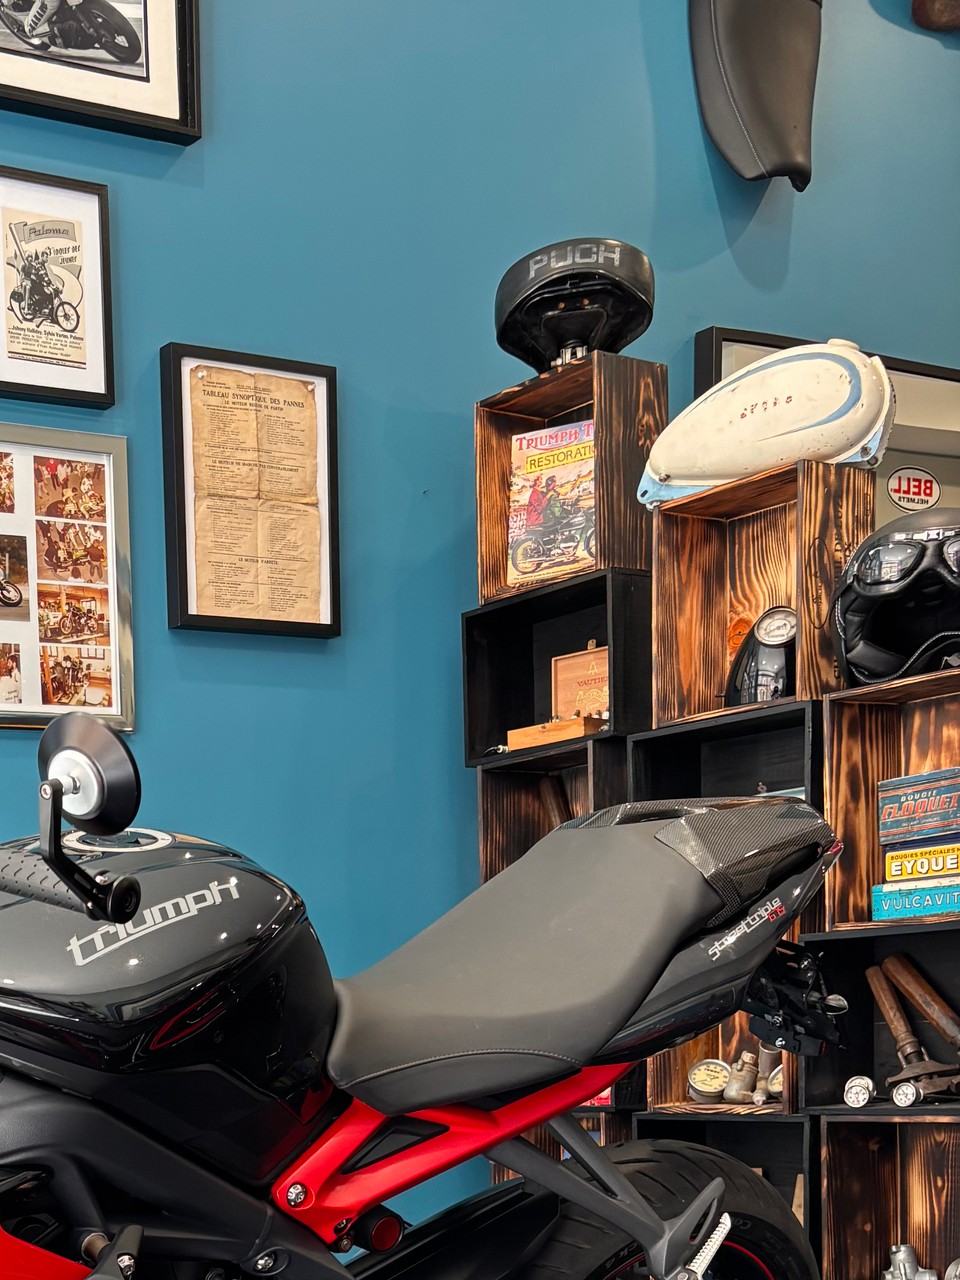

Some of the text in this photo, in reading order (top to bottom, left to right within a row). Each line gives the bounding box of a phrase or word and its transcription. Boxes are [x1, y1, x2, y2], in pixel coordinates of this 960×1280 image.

[28, 225, 69, 240] Paloma
[528, 244, 621, 280] PUCH
[202, 389, 229, 399] TABLEAU
[283, 399, 305, 409] PANNES
[516, 428, 580, 451] TRIUMPH
[900, 789, 938, 802] BOUGIE
[890, 851, 918, 861] BOUGIES
[880, 890, 960, 912] VULCAVIT
